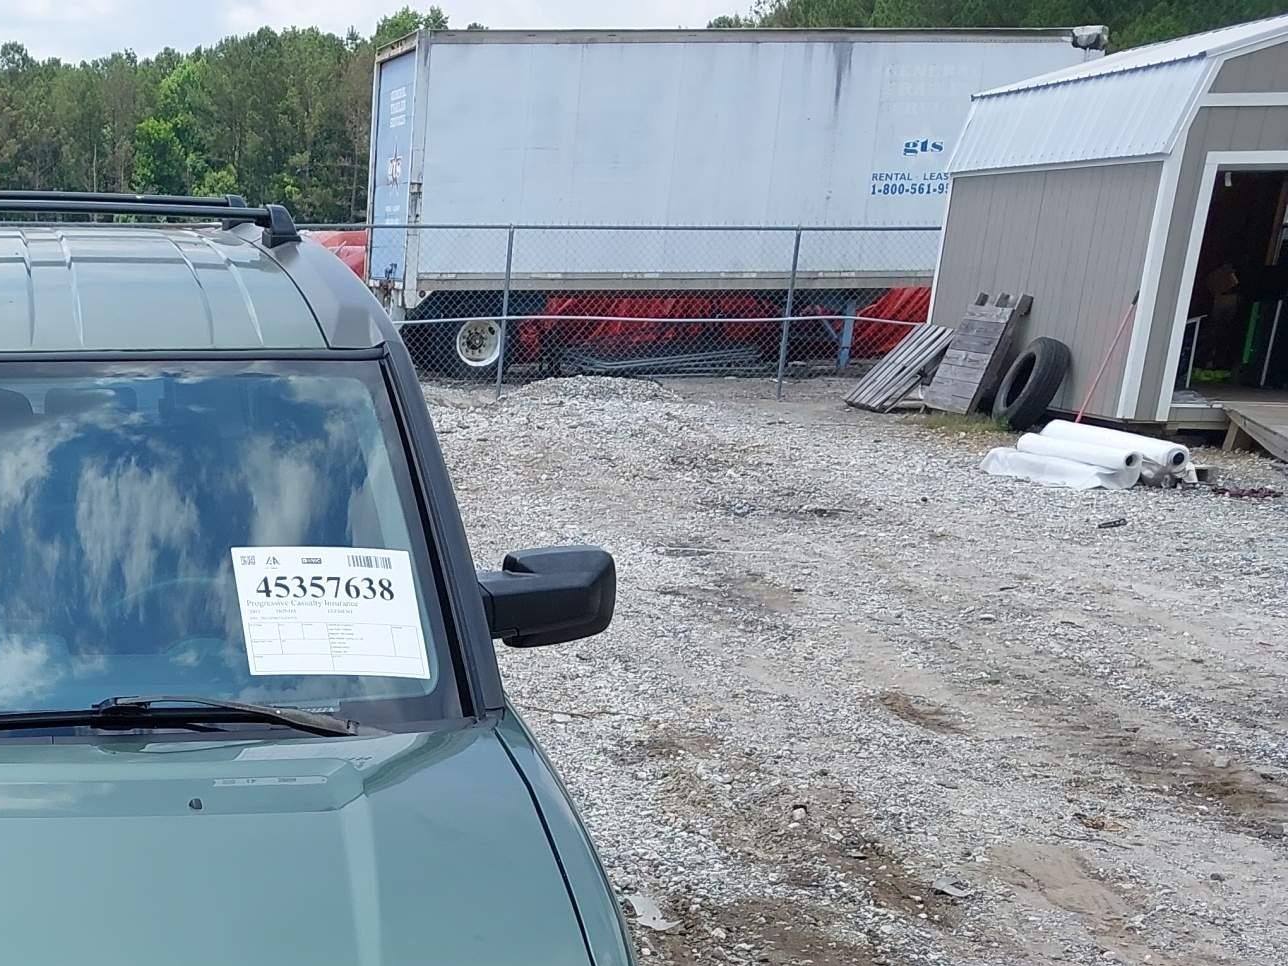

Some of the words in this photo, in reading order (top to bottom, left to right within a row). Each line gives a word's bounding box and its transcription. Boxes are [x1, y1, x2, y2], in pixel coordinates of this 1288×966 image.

[903, 139, 944, 156] gts
[872, 172, 913, 181] RENTAL
[255, 576, 395, 600] 45357638
